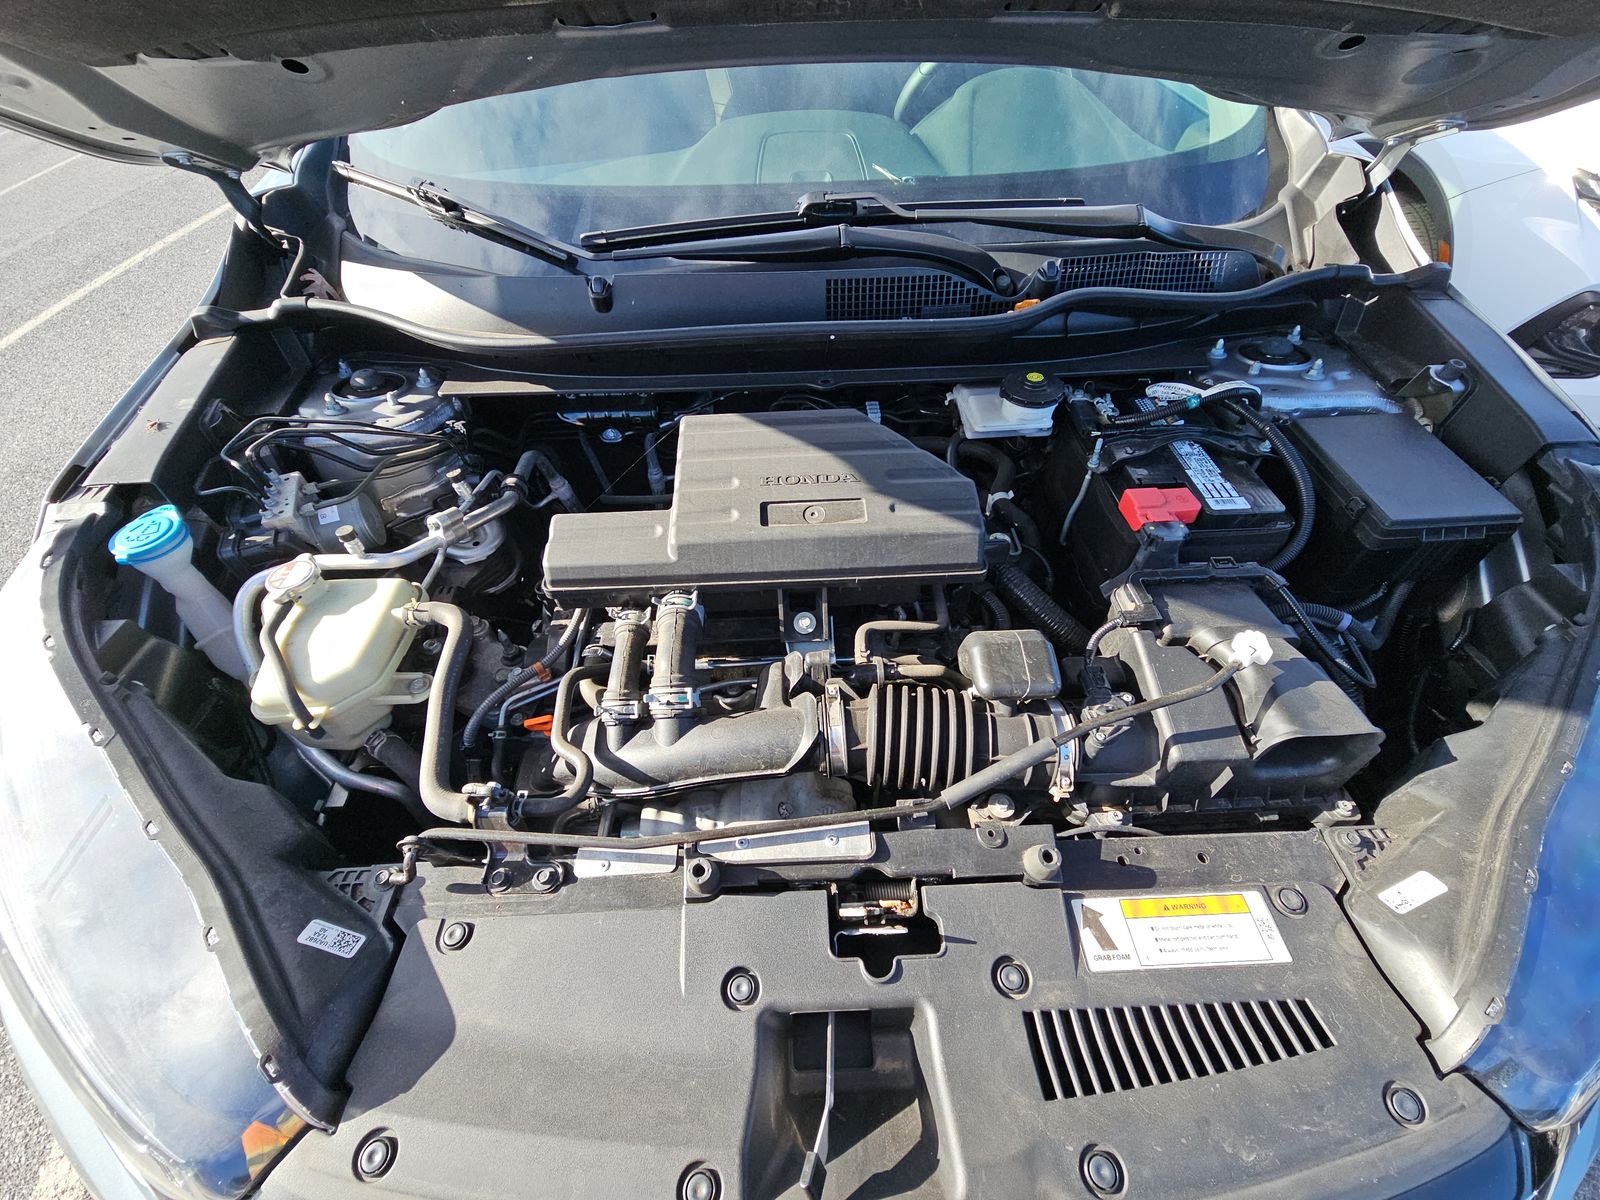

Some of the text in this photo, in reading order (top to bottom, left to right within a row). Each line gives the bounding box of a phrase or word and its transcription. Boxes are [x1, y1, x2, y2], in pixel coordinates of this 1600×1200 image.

[759, 473, 862, 487] HONDA
[1170, 902, 1207, 911] WARNING
[1112, 953, 1131, 961] FOAM
